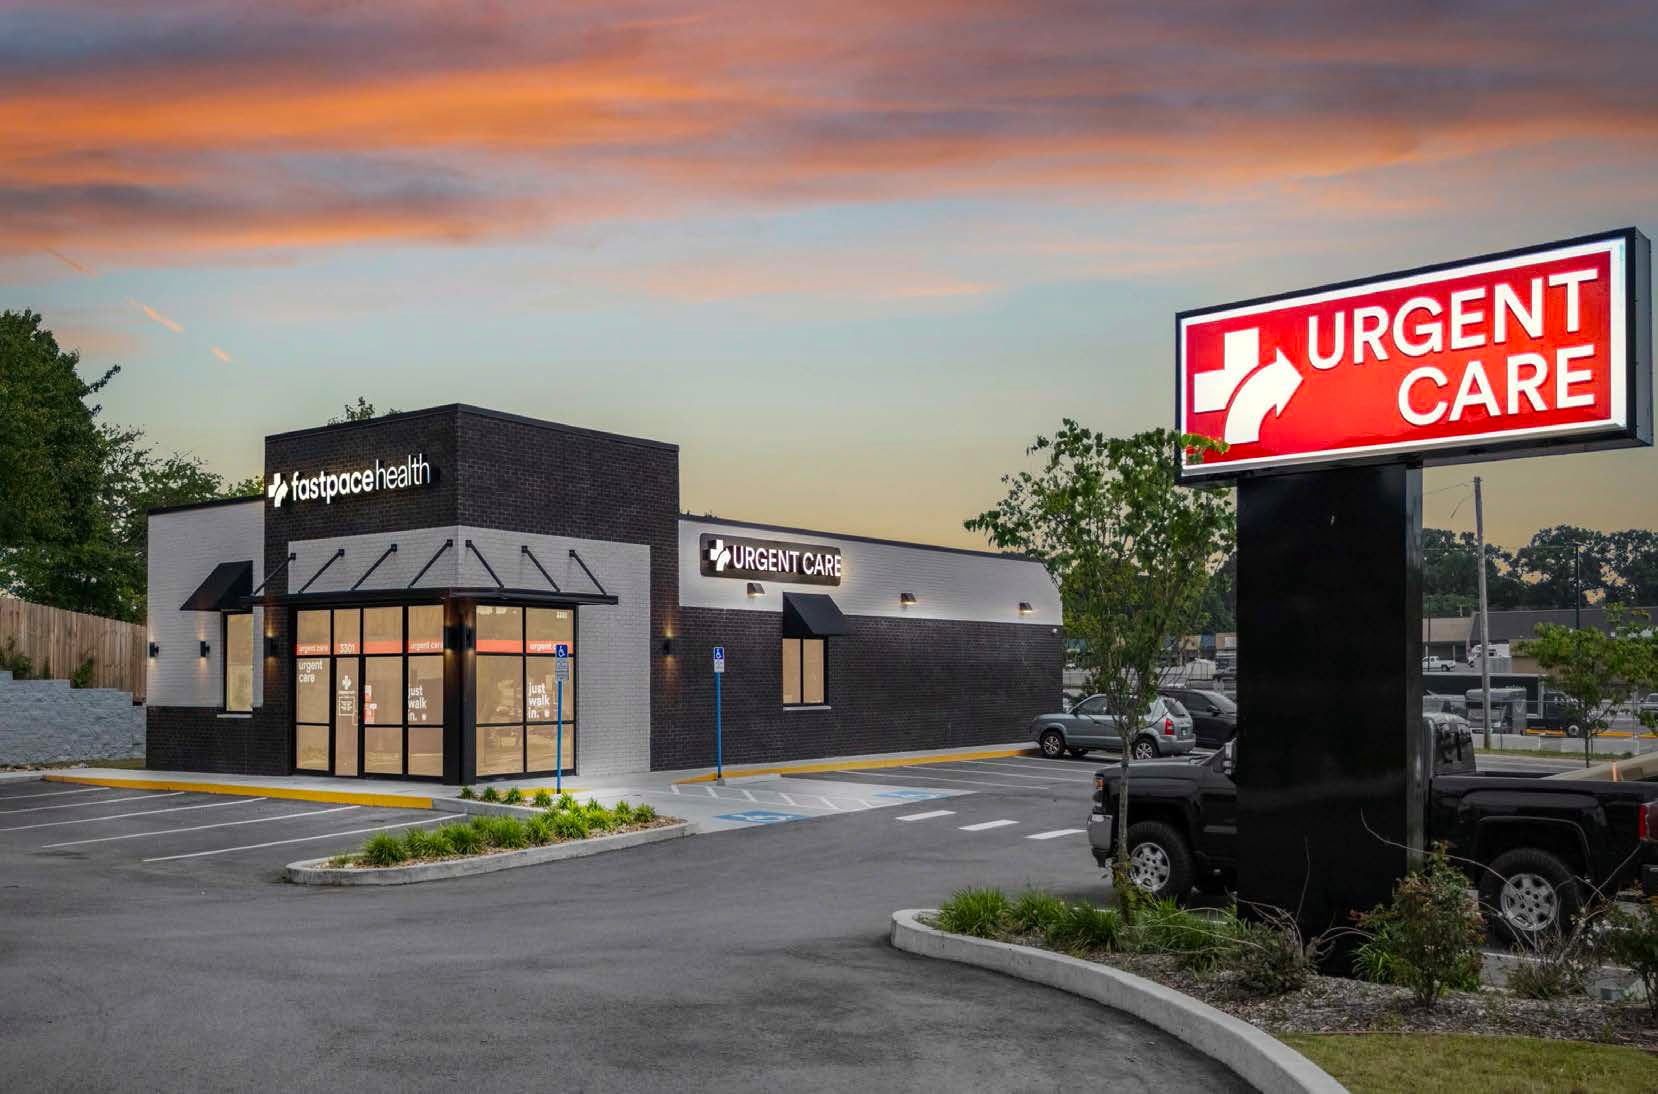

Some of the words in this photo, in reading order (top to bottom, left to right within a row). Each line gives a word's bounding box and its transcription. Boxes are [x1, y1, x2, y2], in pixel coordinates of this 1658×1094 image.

[1307, 268, 1599, 370] URGENT
[1398, 343, 1595, 426] CARE
[291, 453, 430, 504] fastpacehealth
[733, 545, 799, 573] URGENT
[802, 552, 842, 577] CARE
[410, 643, 430, 652] urgent
[529, 643, 551, 652] urgent
[298, 660, 323, 673] urgent
[299, 673, 315, 683] care
[408, 684, 423, 697] just
[528, 682, 546, 695] just
[408, 697, 427, 709] walk
[528, 694, 550, 706] walk
[528, 707, 540, 719] in.
